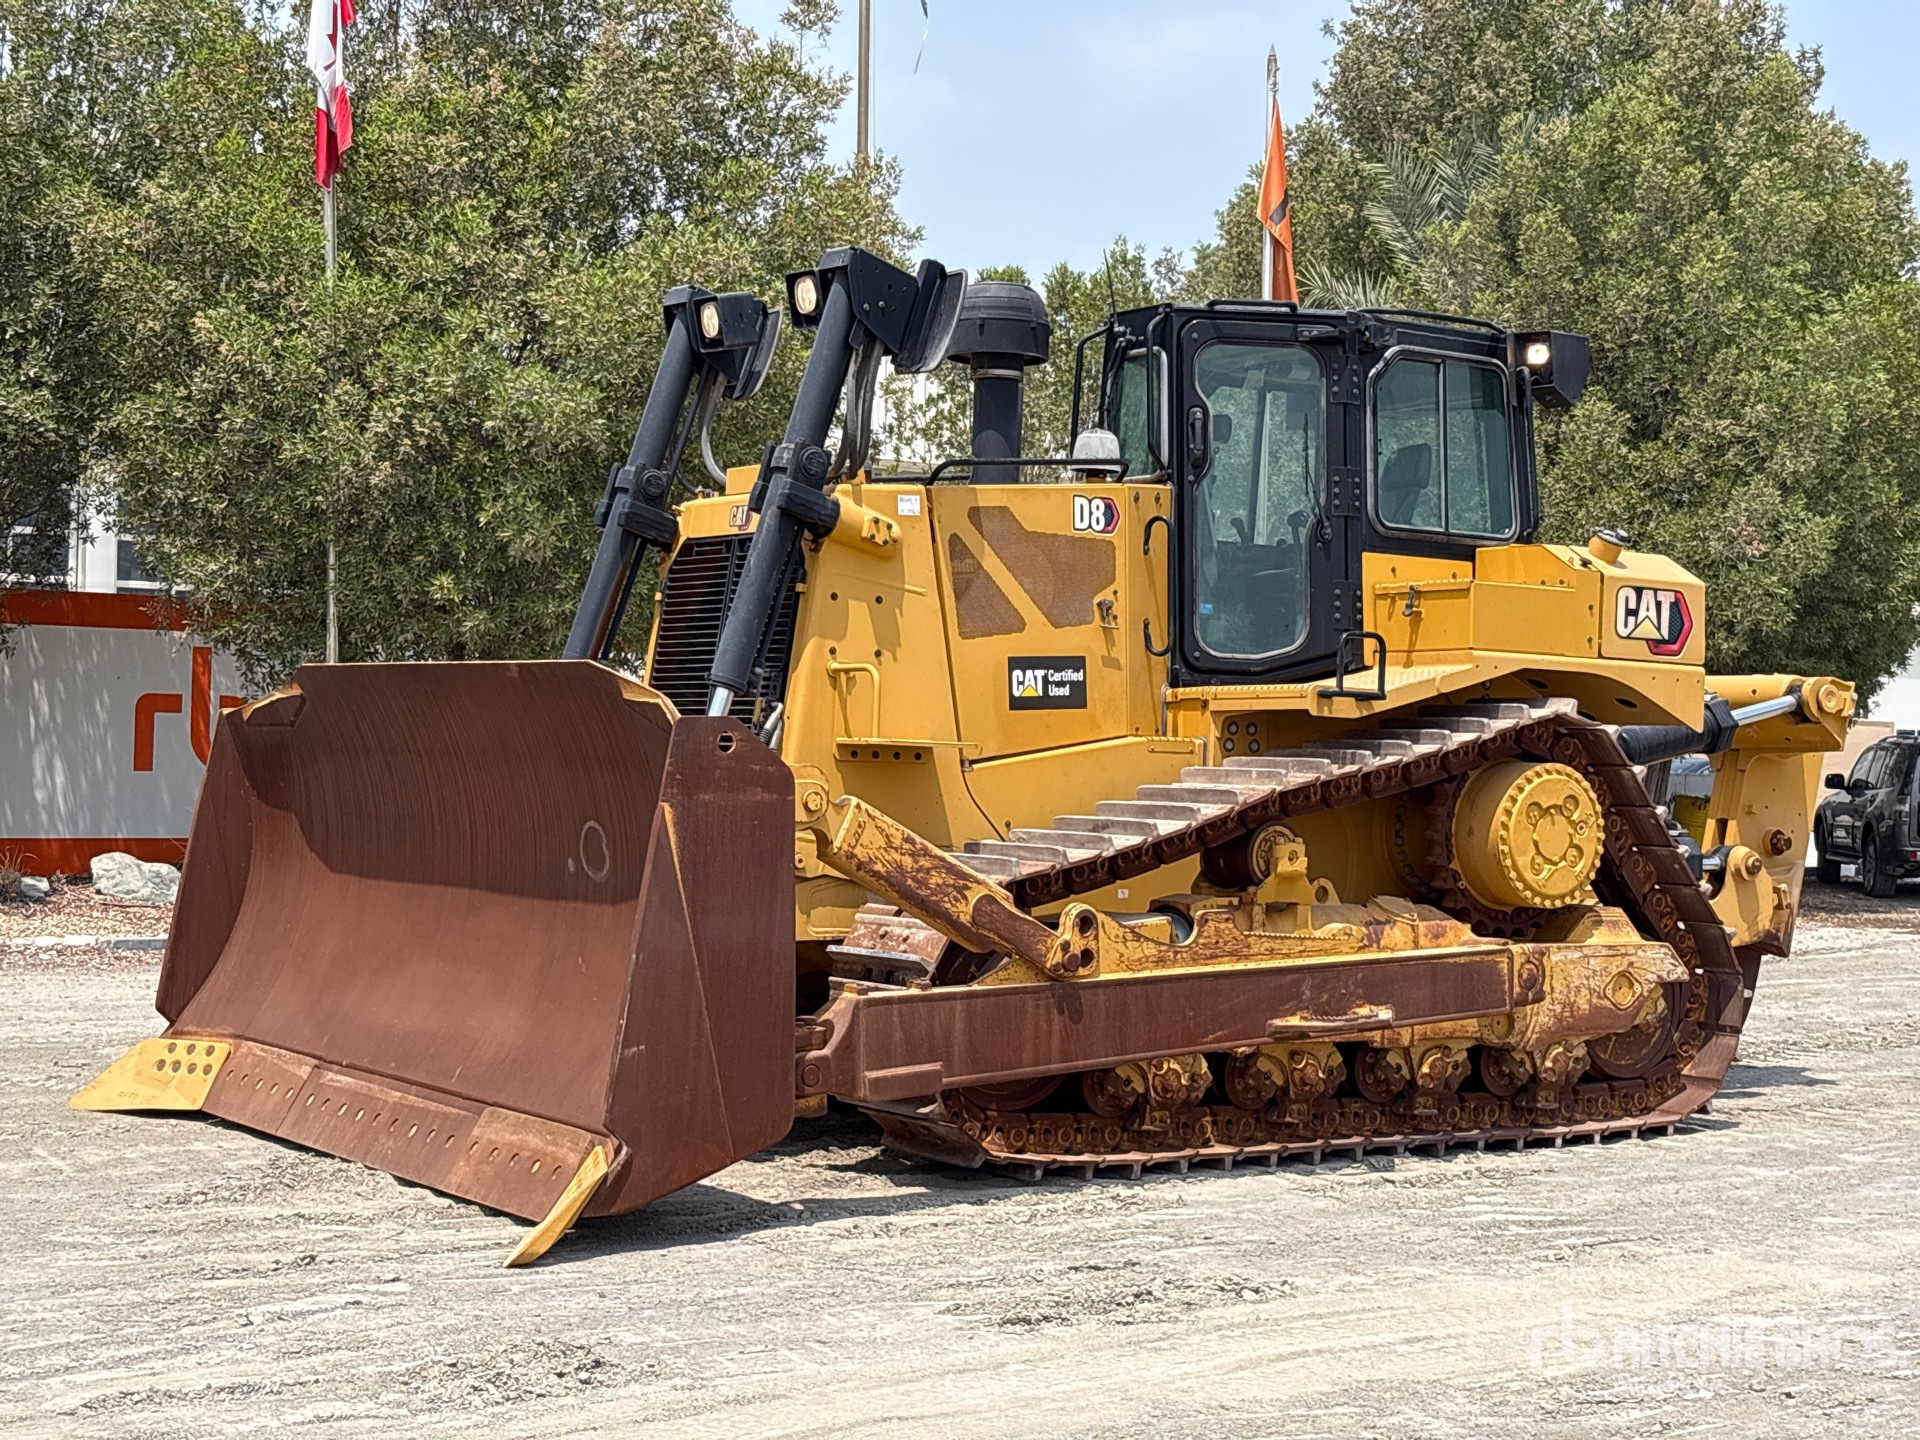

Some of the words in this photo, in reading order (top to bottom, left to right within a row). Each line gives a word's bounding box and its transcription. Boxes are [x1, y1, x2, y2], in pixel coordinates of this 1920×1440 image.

[730, 505, 749, 526] CAT
[1073, 495, 1106, 532] D8
[1616, 586, 1676, 640] CAT
[1012, 669, 1045, 697] CAT
[1048, 669, 1083, 681] Certified
[1048, 684, 1070, 696] Used
